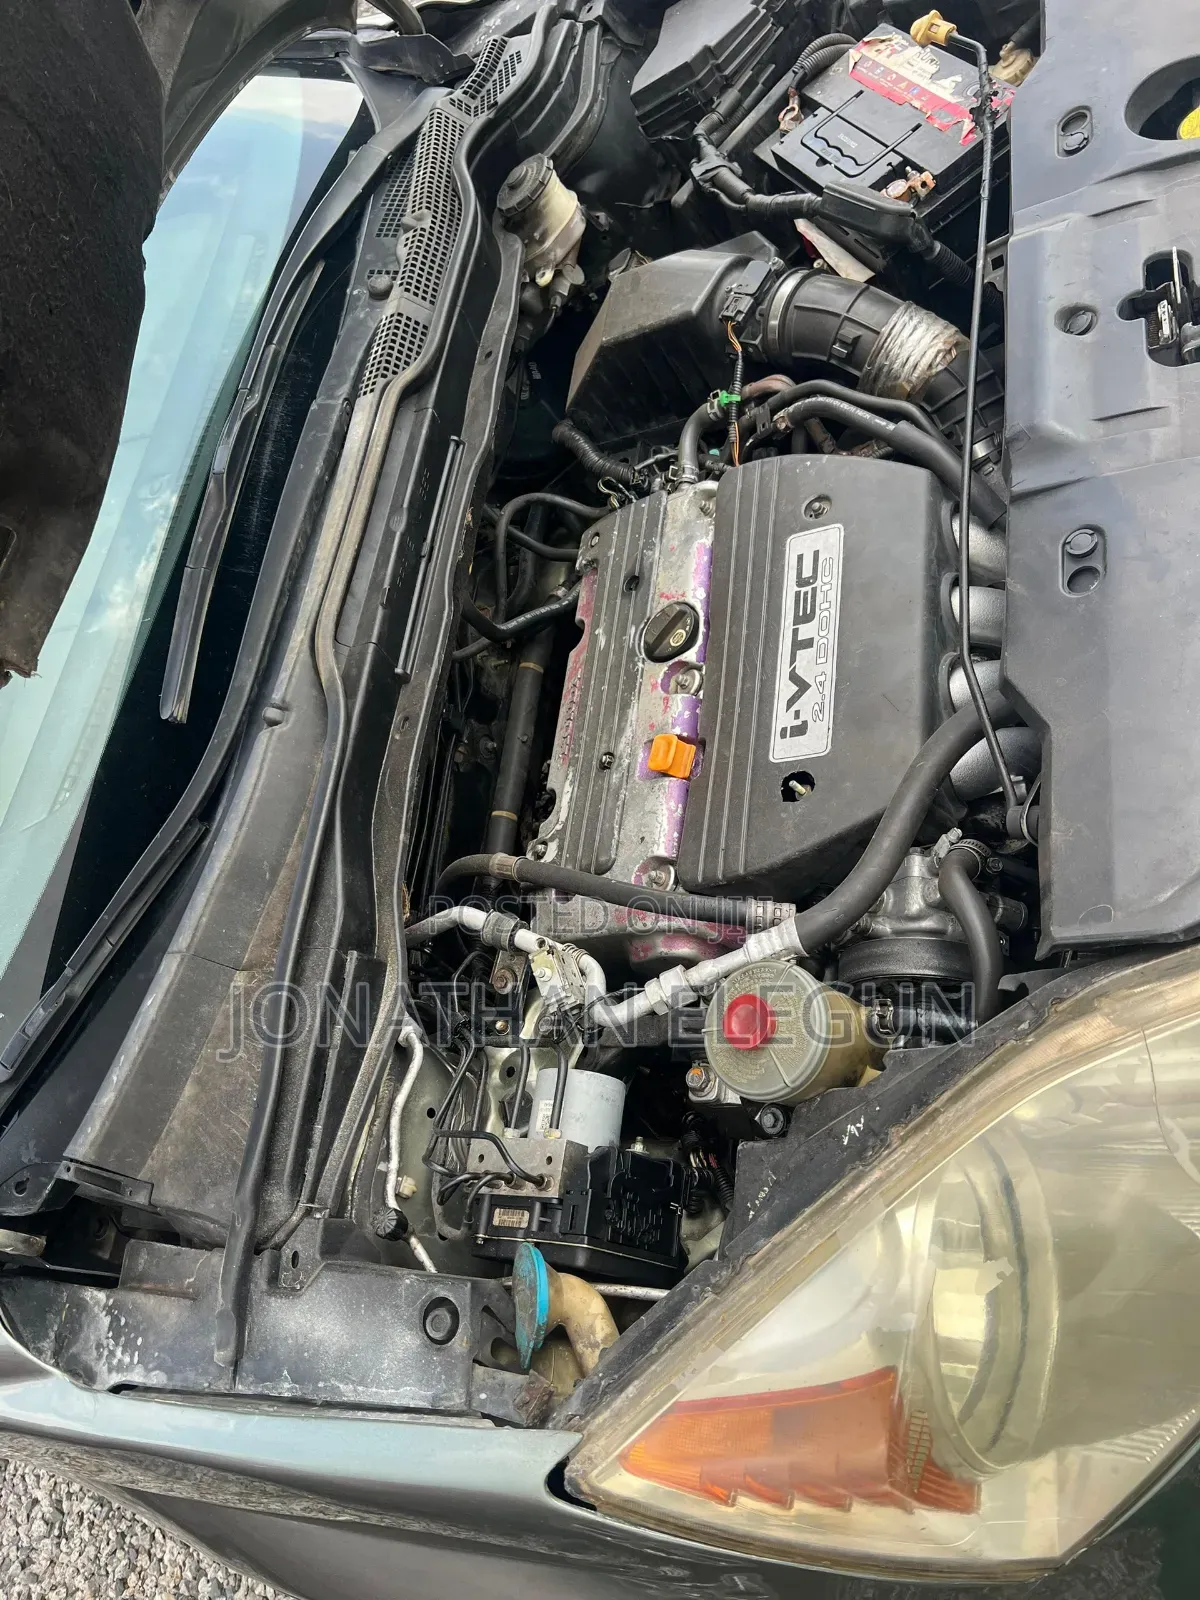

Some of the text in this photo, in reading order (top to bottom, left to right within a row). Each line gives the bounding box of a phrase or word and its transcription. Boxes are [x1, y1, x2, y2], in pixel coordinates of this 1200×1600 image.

[780, 550, 819, 739] i-VTEC
[812, 556, 834, 722] 2.4 DOHC
